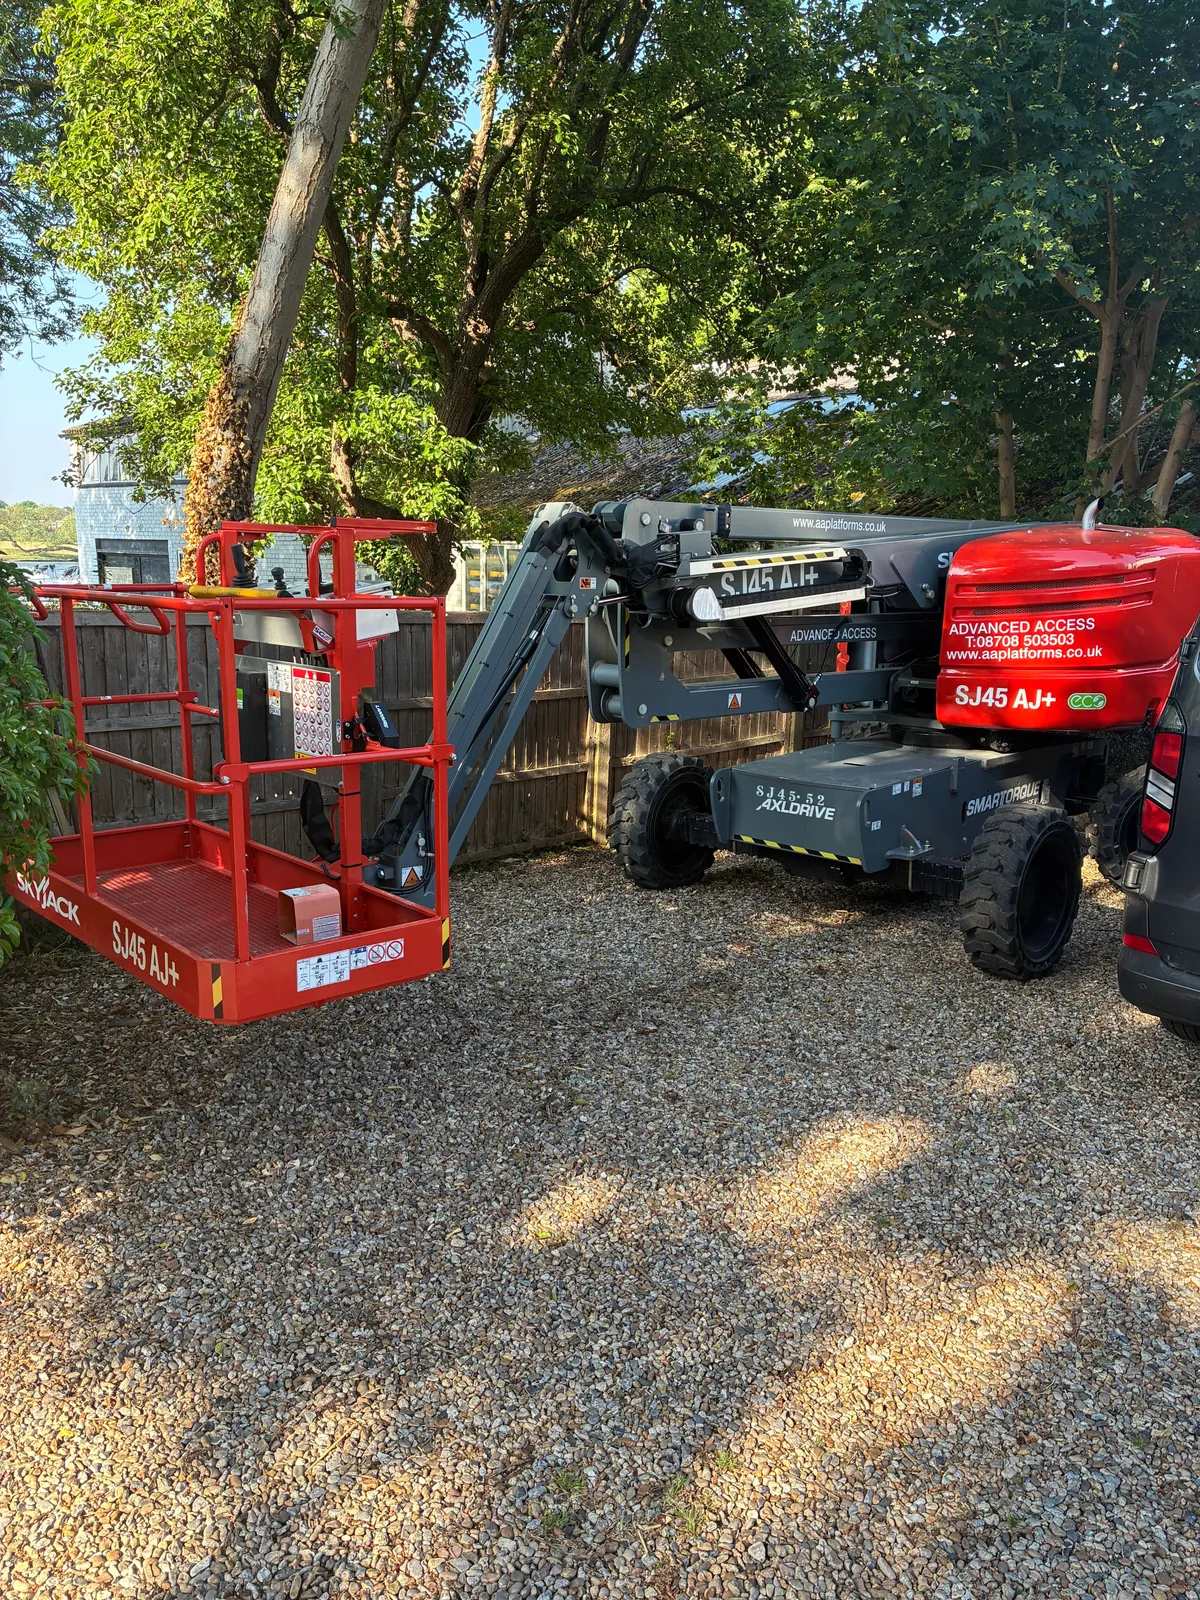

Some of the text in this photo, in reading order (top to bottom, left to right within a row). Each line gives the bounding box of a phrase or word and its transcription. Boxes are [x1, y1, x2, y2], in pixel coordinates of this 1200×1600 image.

[792, 517, 887, 533] www.aaplatforms.co.uk
[842, 627, 877, 640] ACCESS
[949, 617, 1095, 635] ADVANCED ACCESS
[965, 633, 1075, 648] T:08708 503503
[946, 645, 1103, 662] www.aaplatforms.co.uk
[954, 684, 1057, 709] SJ45 AJ+
[1070, 695, 1105, 708] eco
[756, 799, 836, 821] AXLDRIVE
[16, 872, 81, 927] SKYJACK
[112, 920, 180, 987] SJ45 AJ+
